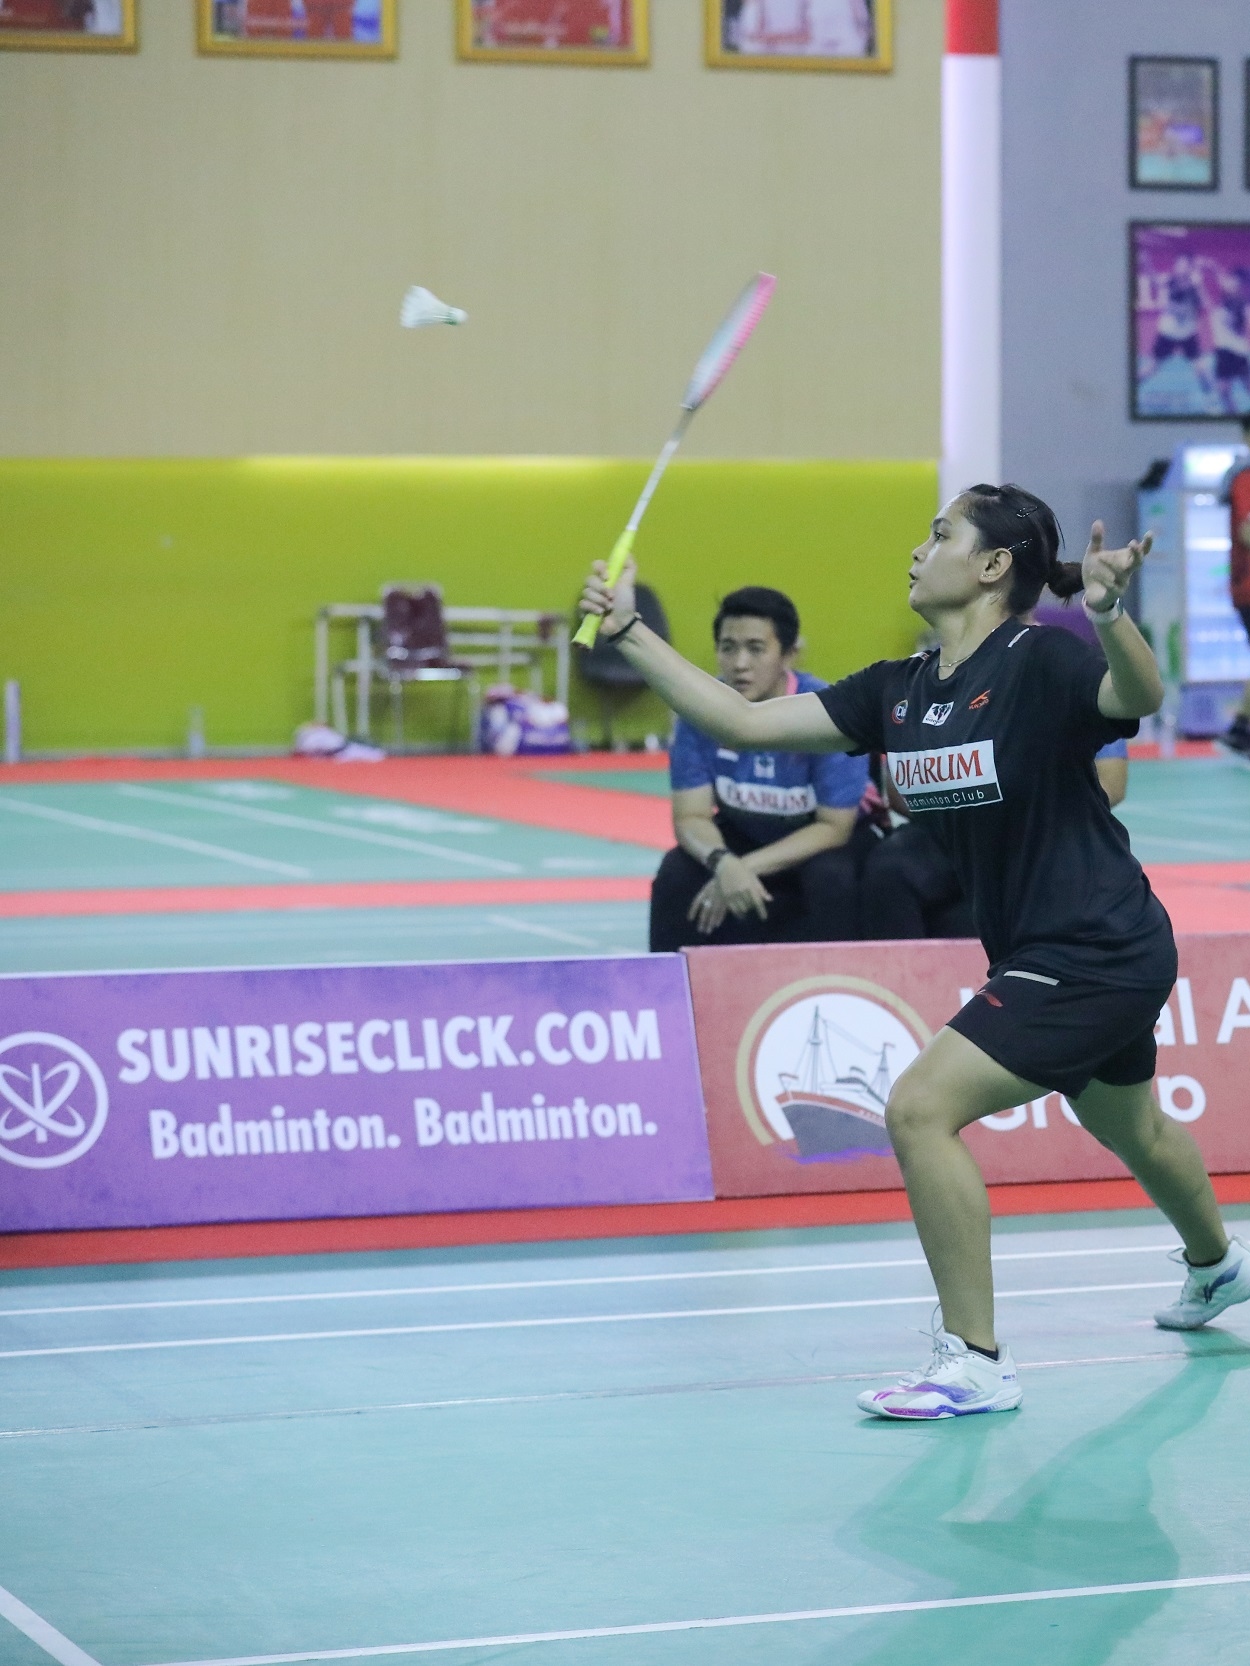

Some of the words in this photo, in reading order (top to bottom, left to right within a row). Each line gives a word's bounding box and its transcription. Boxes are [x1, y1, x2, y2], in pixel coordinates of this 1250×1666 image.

[895, 749, 984, 789] DJARUM
[952, 789, 985, 804] Club
[117, 1008, 662, 1084] SUNRISECLICK.COM
[149, 1103, 401, 1160] Badminton.
[413, 1092, 657, 1147] Badminton.
